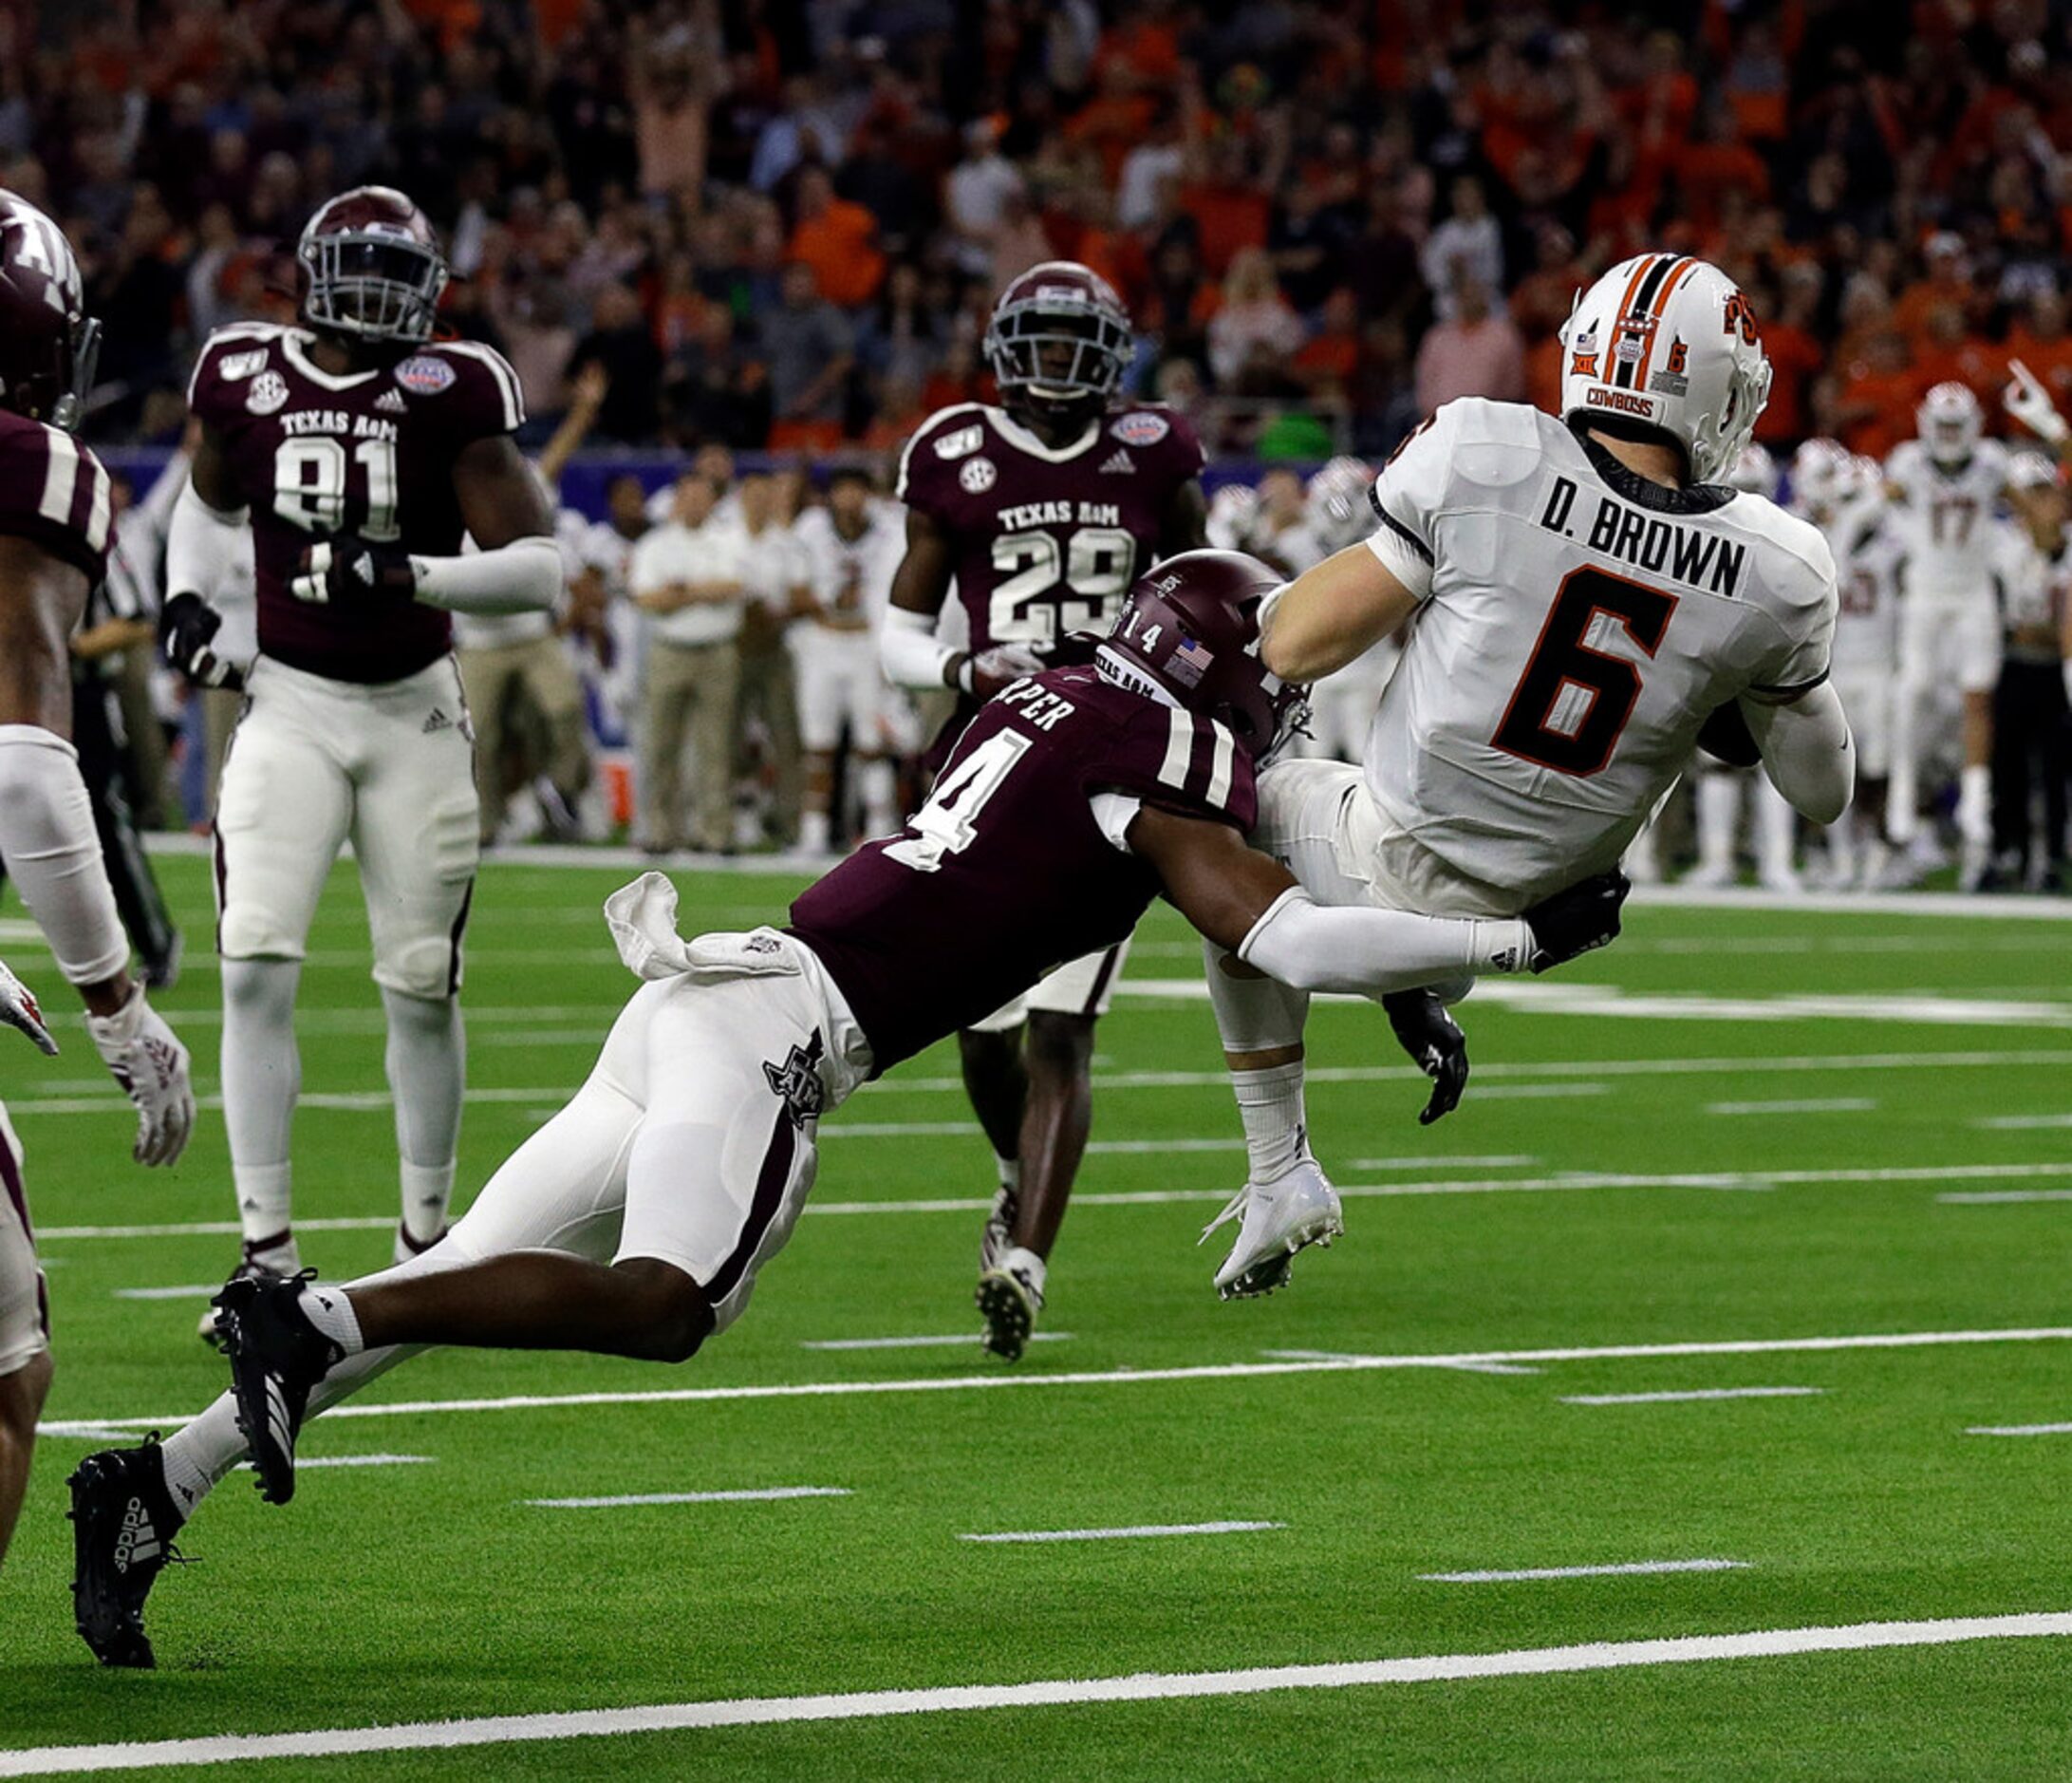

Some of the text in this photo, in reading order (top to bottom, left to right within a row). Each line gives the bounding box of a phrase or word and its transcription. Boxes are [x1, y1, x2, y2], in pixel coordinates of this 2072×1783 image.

[1667, 342, 1688, 373] 6
[1586, 387, 1653, 417] COWBOYS
[279, 410, 398, 443] TEXAS A&M
[998, 500, 1120, 532] TEXAS A&M
[1540, 476, 1577, 537] D.
[1588, 497, 1745, 597] BROWN
[1931, 495, 1977, 548] 17
[988, 528, 1137, 643] 29
[1123, 610, 1163, 654] 14
[1489, 562, 1680, 779] 6
[114, 1496, 140, 1573] adidas
